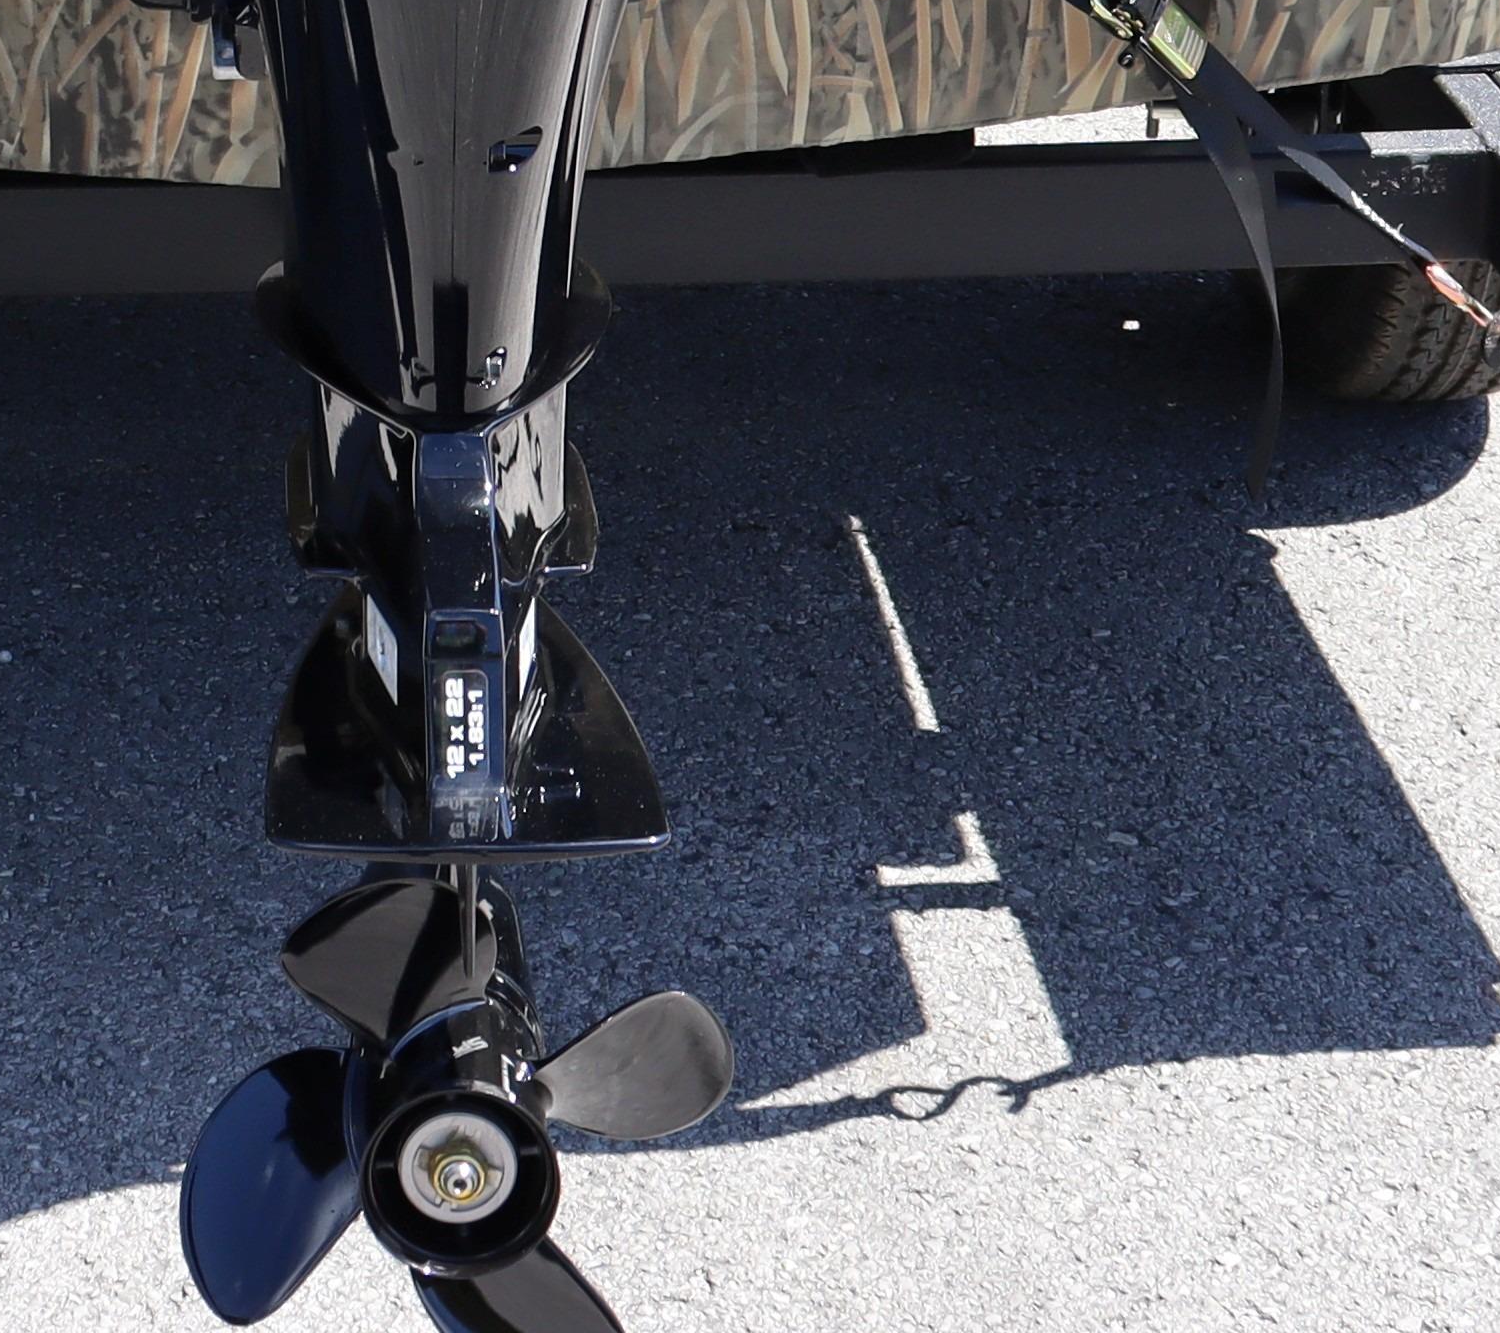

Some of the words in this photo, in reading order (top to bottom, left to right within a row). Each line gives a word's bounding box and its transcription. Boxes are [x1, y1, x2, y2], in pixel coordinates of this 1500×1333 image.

[444, 678, 464, 718] 22
[467, 689, 485, 766] 1.83:1
[446, 744, 465, 779] 12
